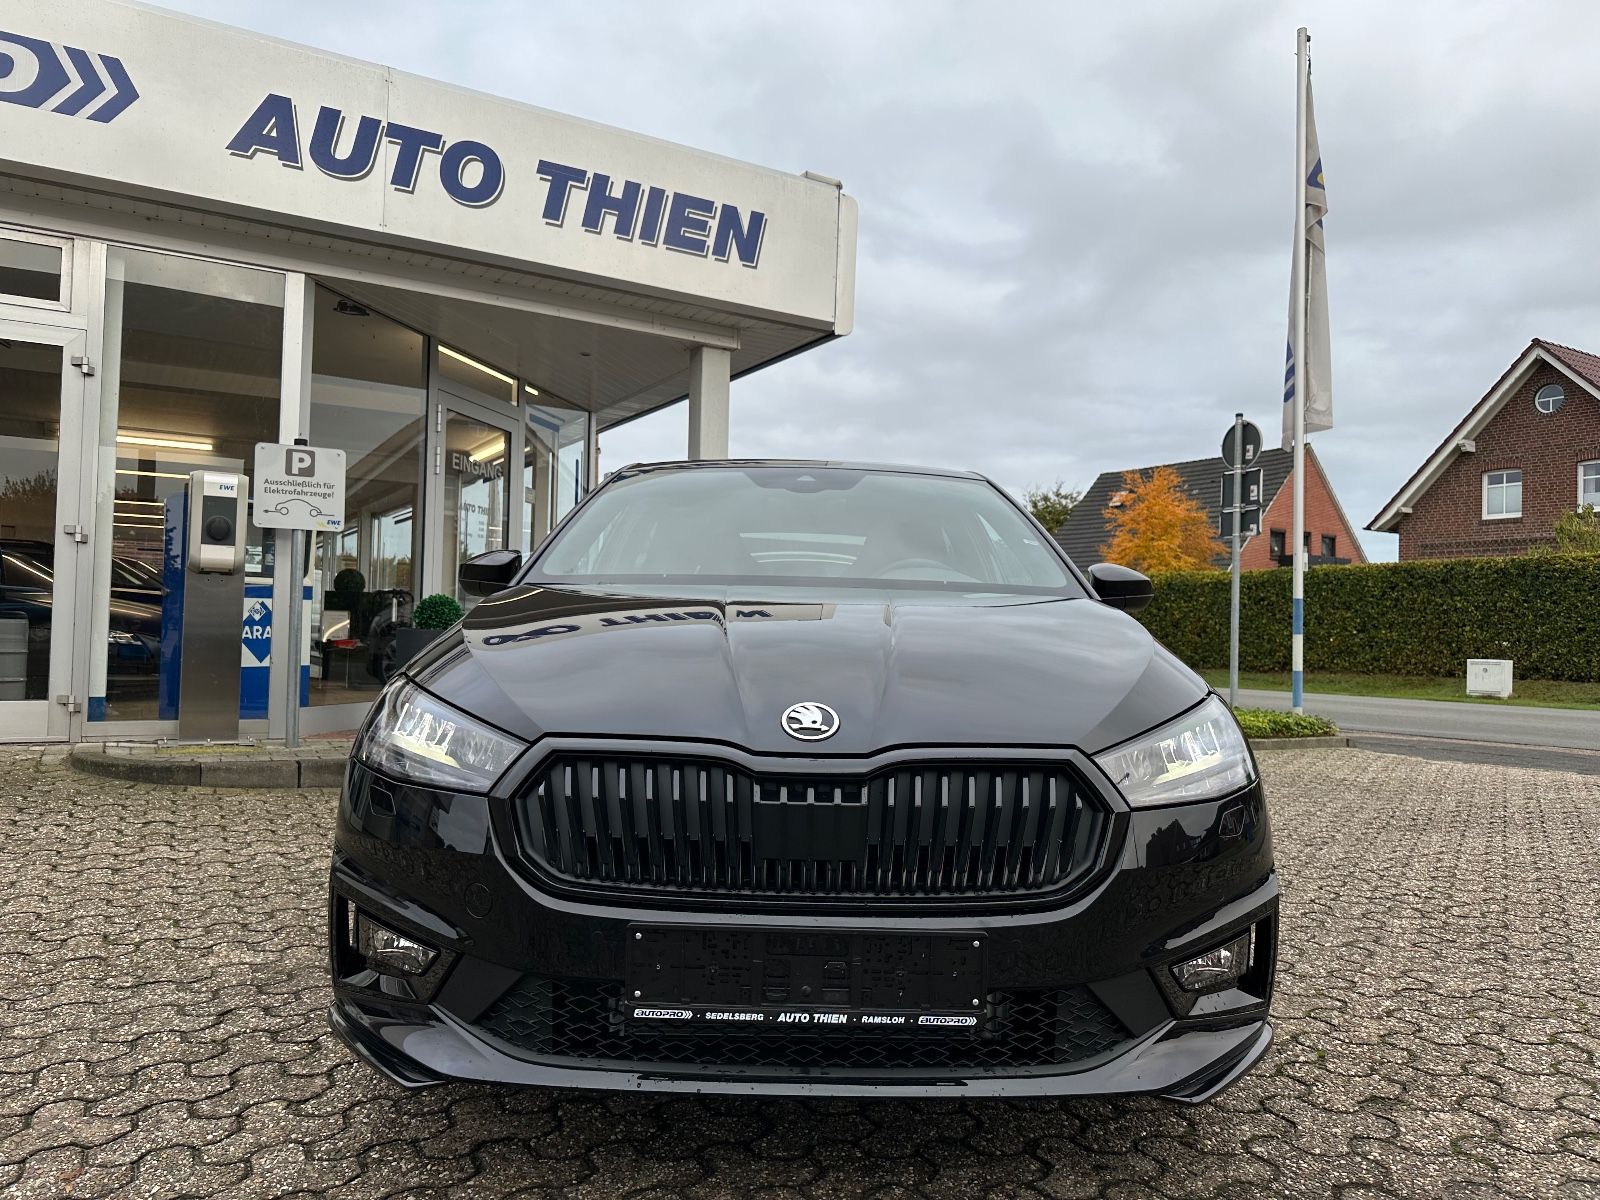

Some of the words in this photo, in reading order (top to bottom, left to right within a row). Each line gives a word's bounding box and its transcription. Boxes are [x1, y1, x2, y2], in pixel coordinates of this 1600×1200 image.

[225, 93, 505, 208] AUTO
[536, 159, 767, 269] THIEN
[291, 451, 312, 475] P
[452, 453, 503, 479] EINGANG
[263, 478, 322, 489] Ausschließlich
[323, 482, 336, 490] für
[263, 487, 335, 499] Elektrofahrzeuge!
[705, 1011, 764, 1021] SEDELSBERG
[777, 1012, 810, 1023] AUTO
[813, 1013, 848, 1024] THIEN
[861, 1015, 905, 1024] RAMSLOH
